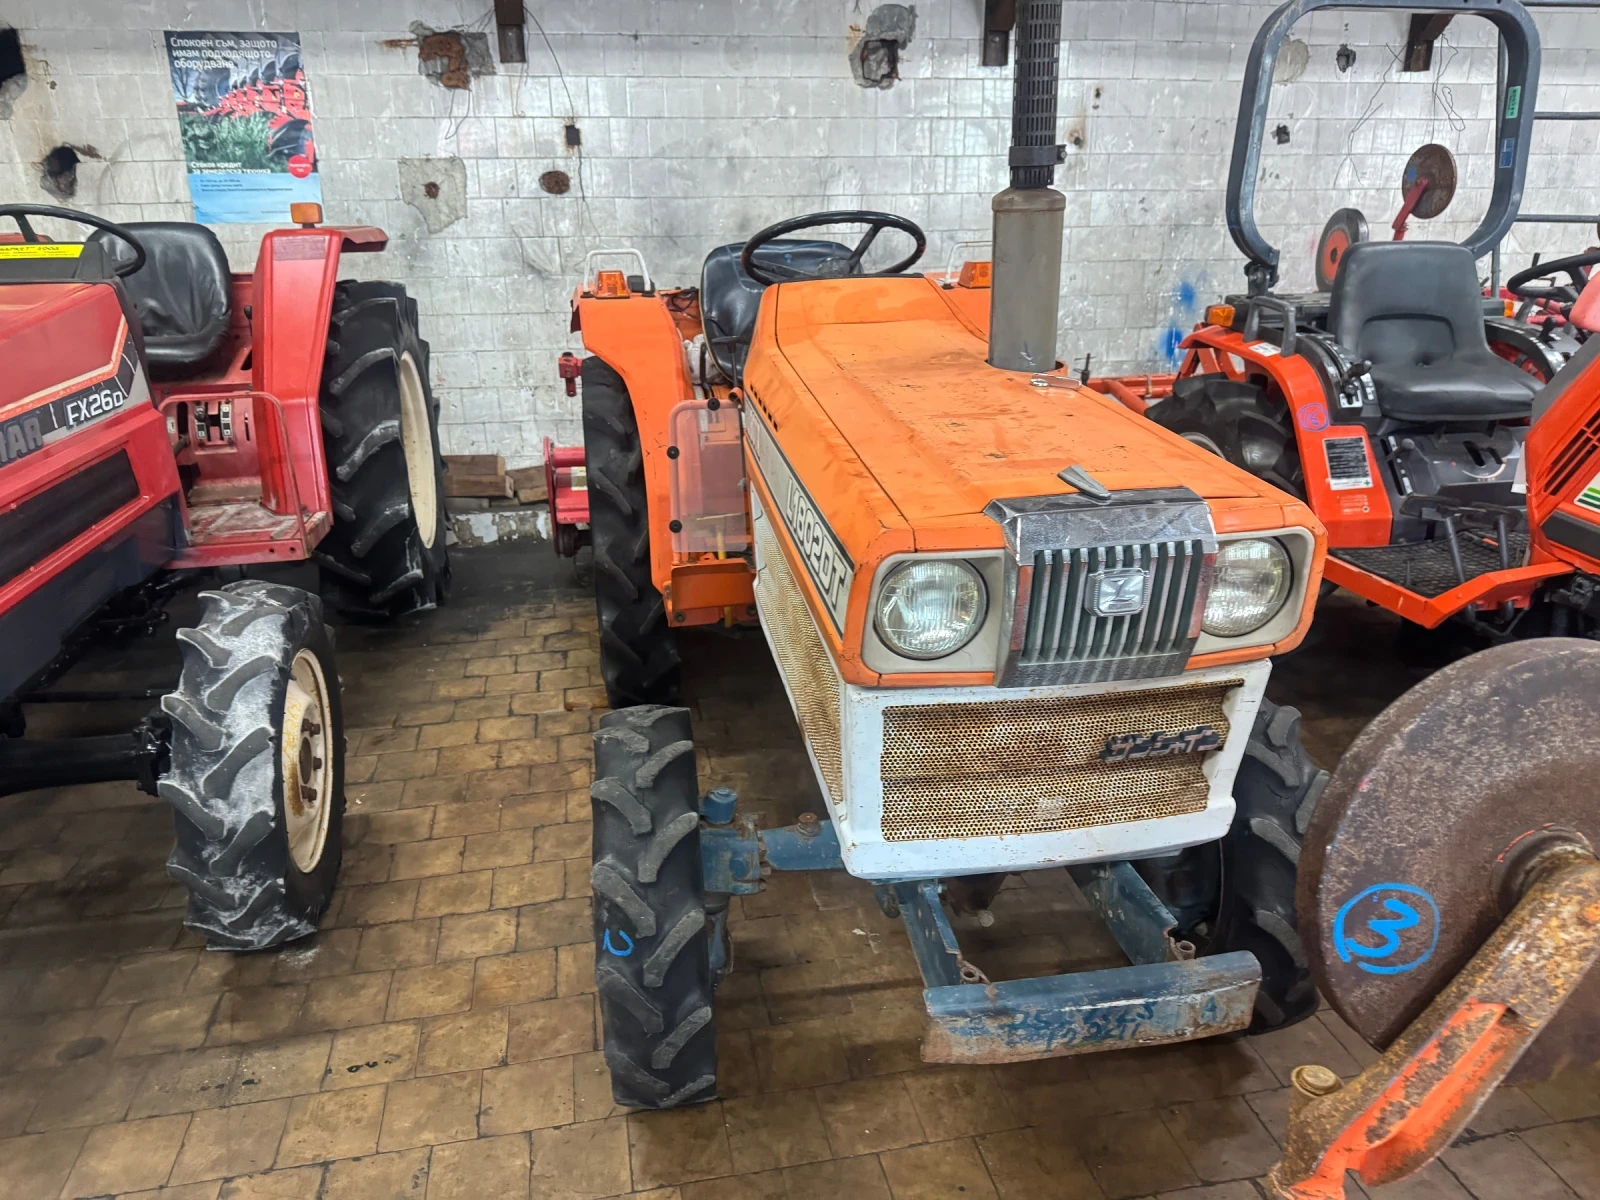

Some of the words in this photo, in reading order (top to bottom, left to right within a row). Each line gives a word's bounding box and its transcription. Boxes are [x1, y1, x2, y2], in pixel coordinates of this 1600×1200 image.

[170, 37, 214, 48] Спокоен
[239, 40, 277, 50] защото
[172, 49, 200, 58] имам
[201, 49, 271, 60] подходящото
